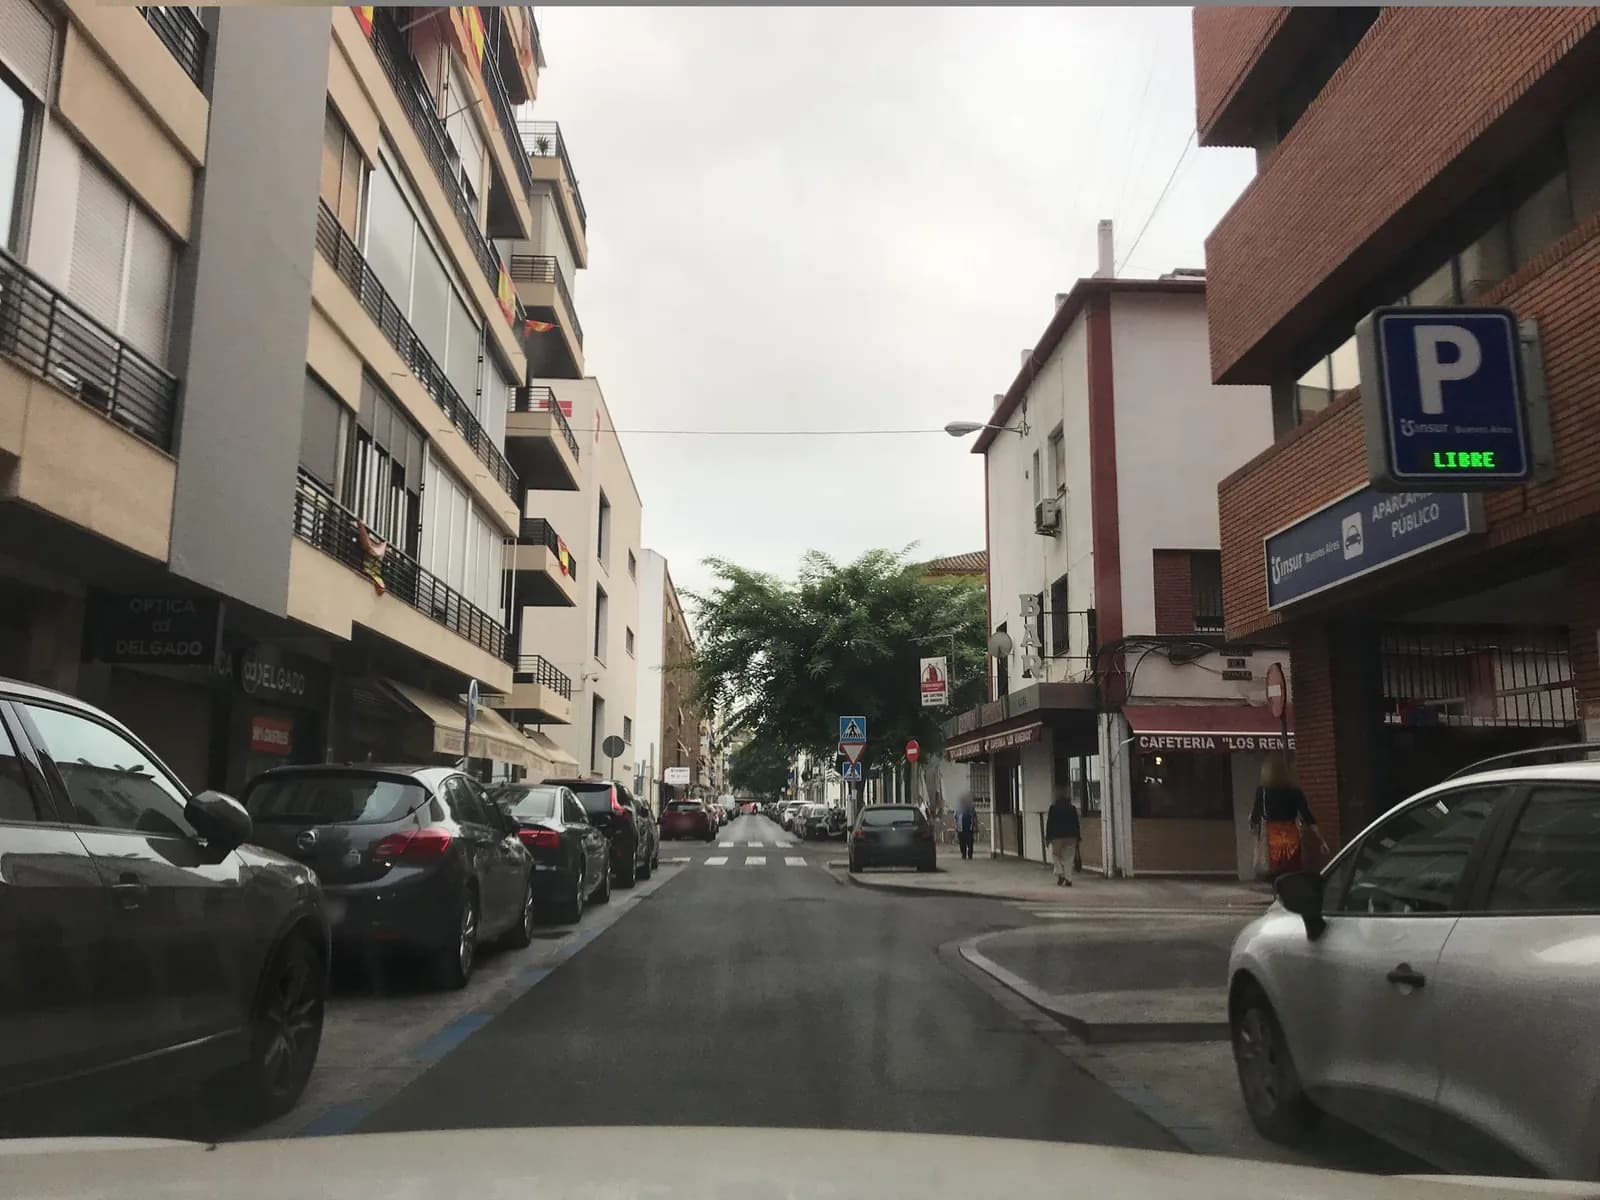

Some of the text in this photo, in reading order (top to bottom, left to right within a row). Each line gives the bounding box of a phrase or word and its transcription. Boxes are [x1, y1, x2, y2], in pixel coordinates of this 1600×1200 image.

[1413, 324, 1482, 415] P
[1432, 451, 1496, 468] LIBRE
[1391, 503, 1440, 538] PÚBLICO
[1325, 541, 1341, 555] Aires
[1019, 594, 1042, 680] BAR
[115, 639, 204, 657] DELGADO
[1139, 736, 1215, 749] CAFETERIA
[1222, 737, 1255, 749] "LOS
